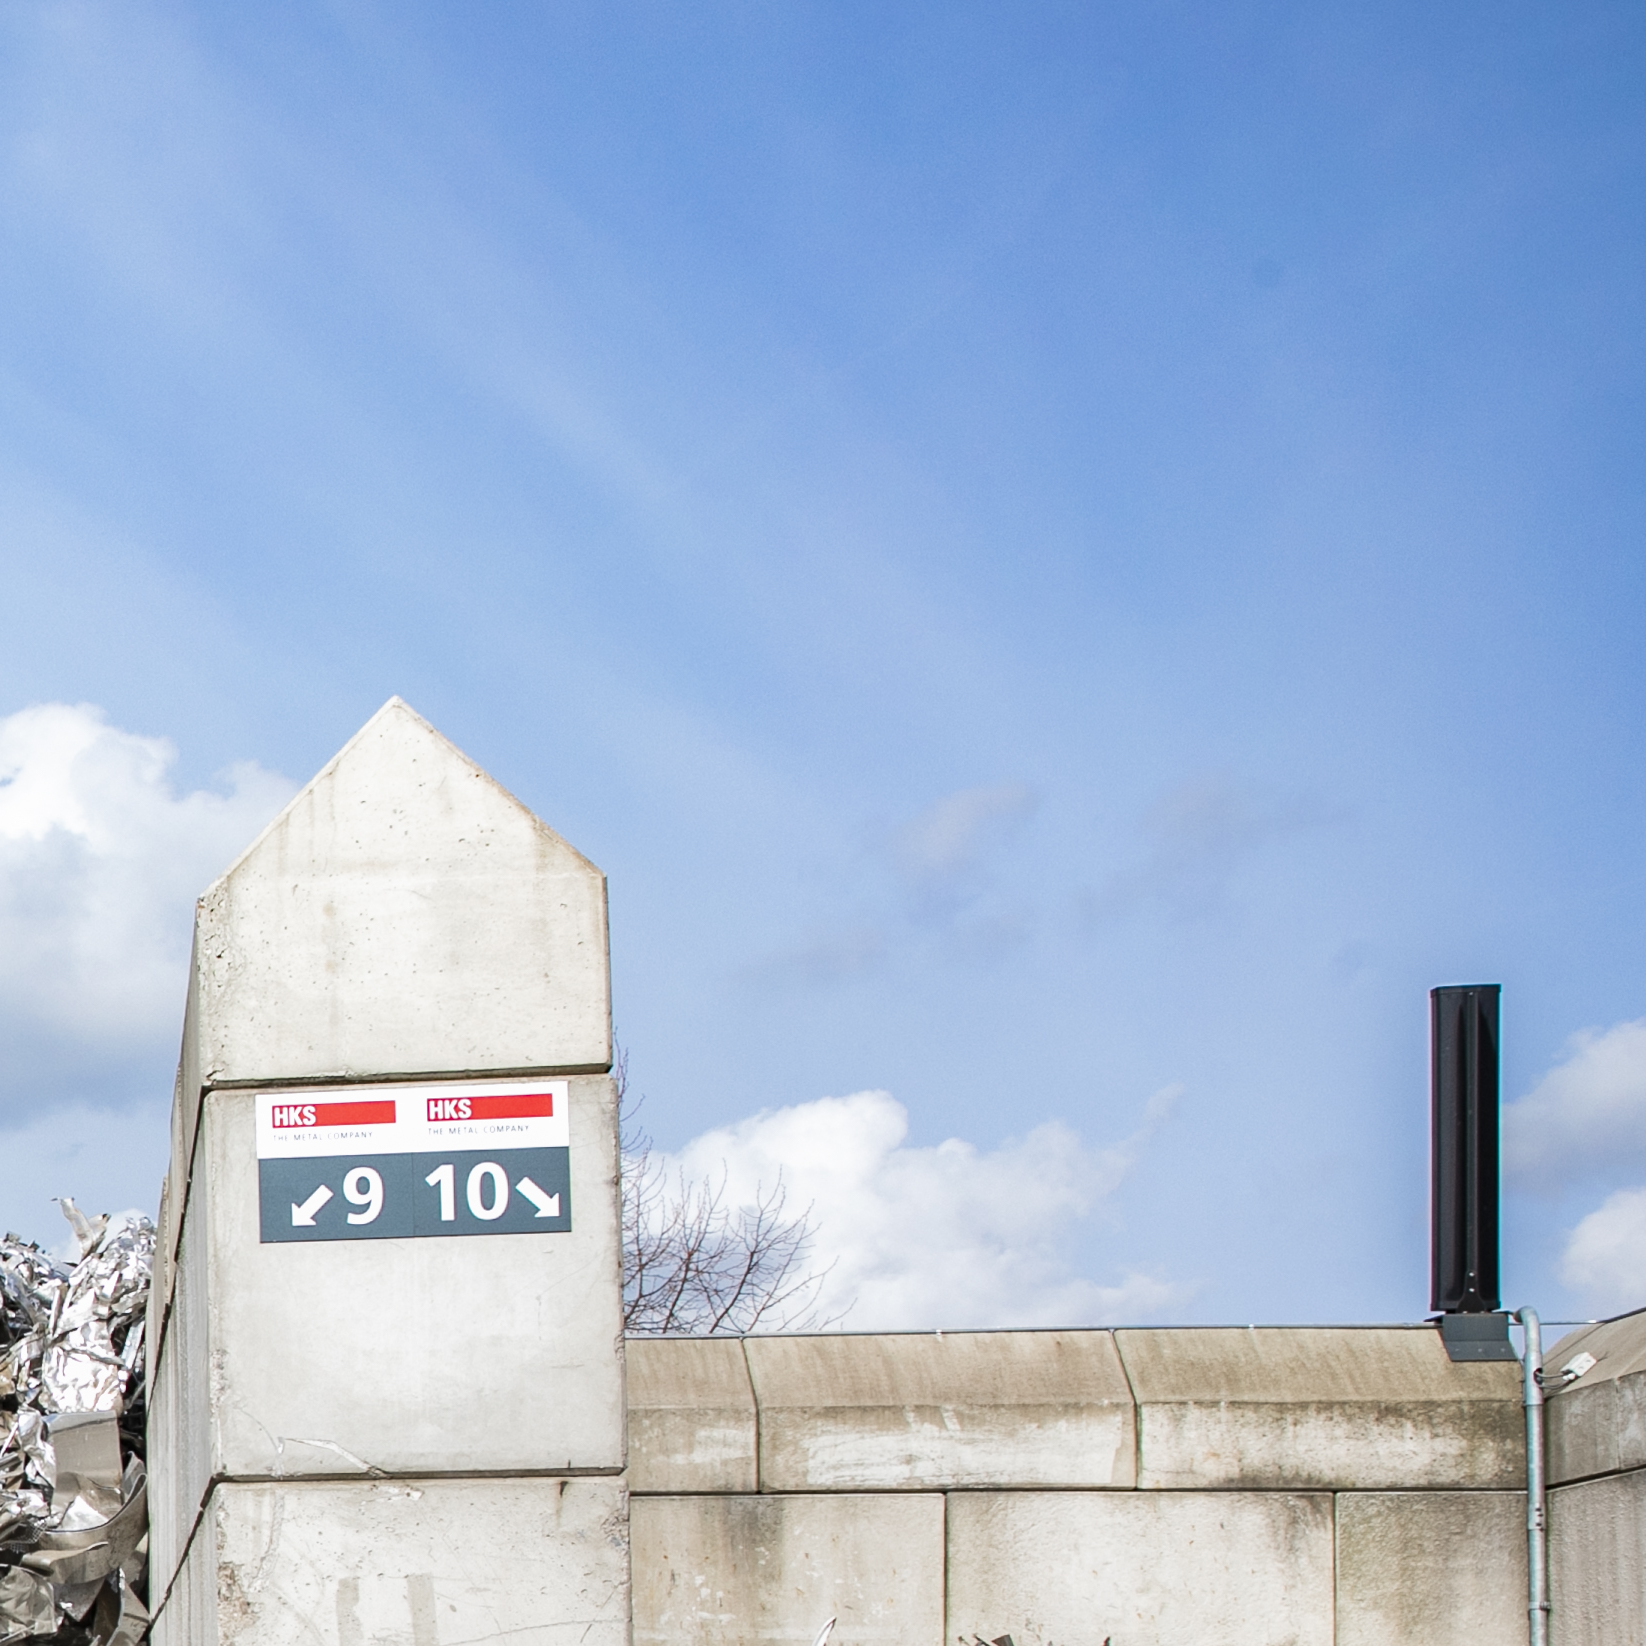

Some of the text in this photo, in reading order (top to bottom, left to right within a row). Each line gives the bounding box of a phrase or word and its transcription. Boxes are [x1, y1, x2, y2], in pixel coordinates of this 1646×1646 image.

[273, 1106, 316, 1126] HKS
[428, 1099, 472, 1120] HKS
[293, 1133, 322, 1141] METAL
[328, 1131, 372, 1139] COMPANY
[449, 1126, 478, 1134] METAL
[483, 1125, 529, 1133] COMPANY
[342, 1166, 384, 1225] 9
[424, 1161, 509, 1221] 10
